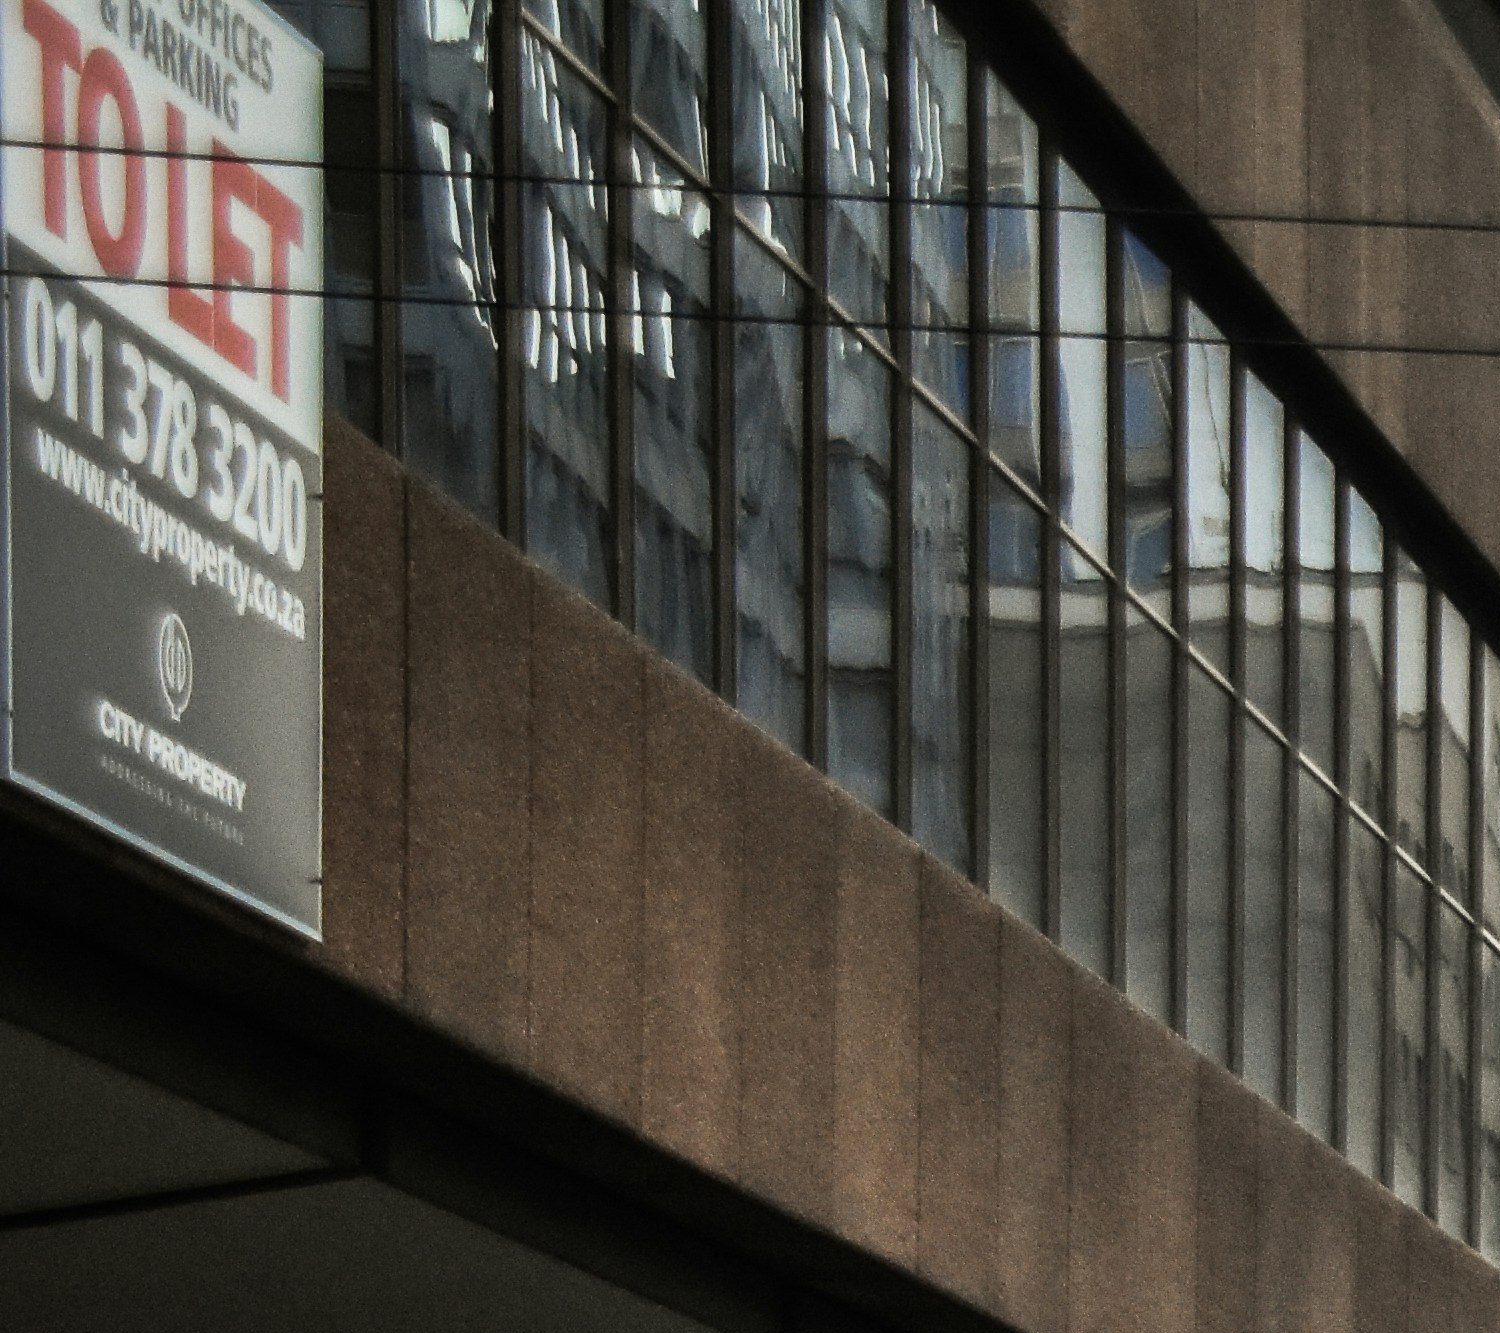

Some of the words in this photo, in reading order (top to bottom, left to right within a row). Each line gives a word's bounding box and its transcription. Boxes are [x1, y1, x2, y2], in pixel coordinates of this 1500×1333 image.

[129, 0, 239, 132] PARKING
[21, 0, 147, 277] TO
[166, 101, 304, 407] LET
[25, 276, 104, 439] 011
[121, 342, 198, 499] 378
[209, 404, 307, 572] 3200
[37, 427, 306, 640] www.cityproperty.co.za
[100, 700, 145, 754] CITY
[149, 729, 246, 812] PROPERTY
